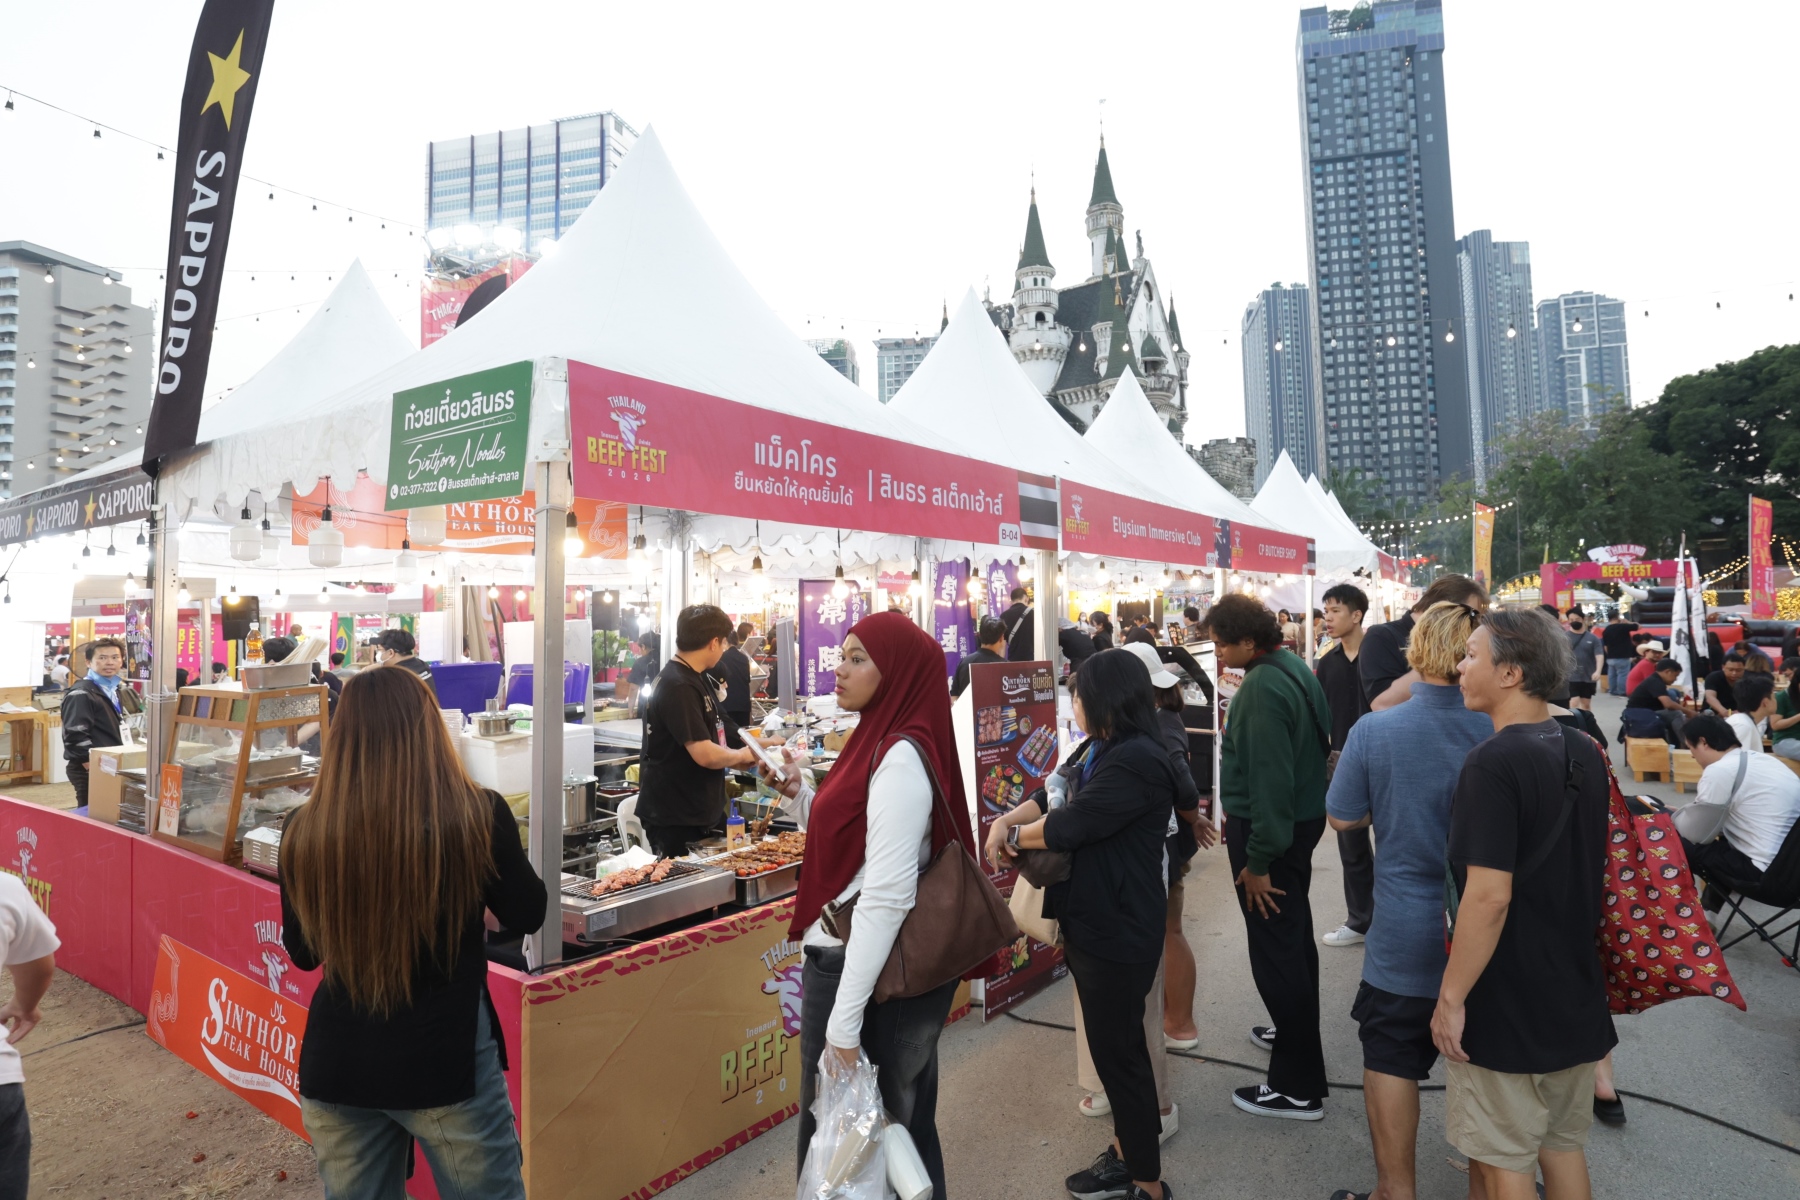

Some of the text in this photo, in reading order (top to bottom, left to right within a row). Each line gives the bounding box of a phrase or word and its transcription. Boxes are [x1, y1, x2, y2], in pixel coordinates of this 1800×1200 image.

[158, 149, 226, 395] SAPPORO
[430, 302, 465, 321] THAILA
[404, 388, 515, 431] ก๋วยเตี๋ยวสินธร
[607, 395, 647, 415] THAILAND
[408, 432, 506, 480] Sinthorn Noodles
[587, 436, 667, 474] BEEF FEST
[754, 434, 837, 478] แม็คโคร
[400, 483, 438, 496] 02-377-7322
[608, 468, 651, 482] 2026
[734, 470, 854, 506] ยืนหยัดให้คุณยิ้มได้
[0, 481, 152, 540] PORO SAPPORO SAPPORO
[880, 473, 1003, 516] สินธร สเต็กเฮ้าส์
[451, 502, 536, 523] NTHOR
[451, 520, 535, 535] EAK HOUS
[1001, 528, 1018, 541] B-04
[1112, 515, 1202, 547] Elysium Immersive Club
[1259, 543, 1265, 556] CP
[1265, 545, 1285, 558] BUTCHER
[1286, 548, 1297, 560] SHOP
[1605, 544, 1647, 557] THAILAND
[1601, 564, 1652, 577] BEEF FEST
[254, 919, 287, 952] THAILA
[760, 938, 801, 972] THAIL
[201, 977, 302, 1064] SINTHOR
[746, 1015, 778, 1039] ไทยแลนด์
[258, 1049, 300, 1092] HOUSE
[720, 1028, 791, 1104] BEEF
[756, 1077, 787, 1105] 20
